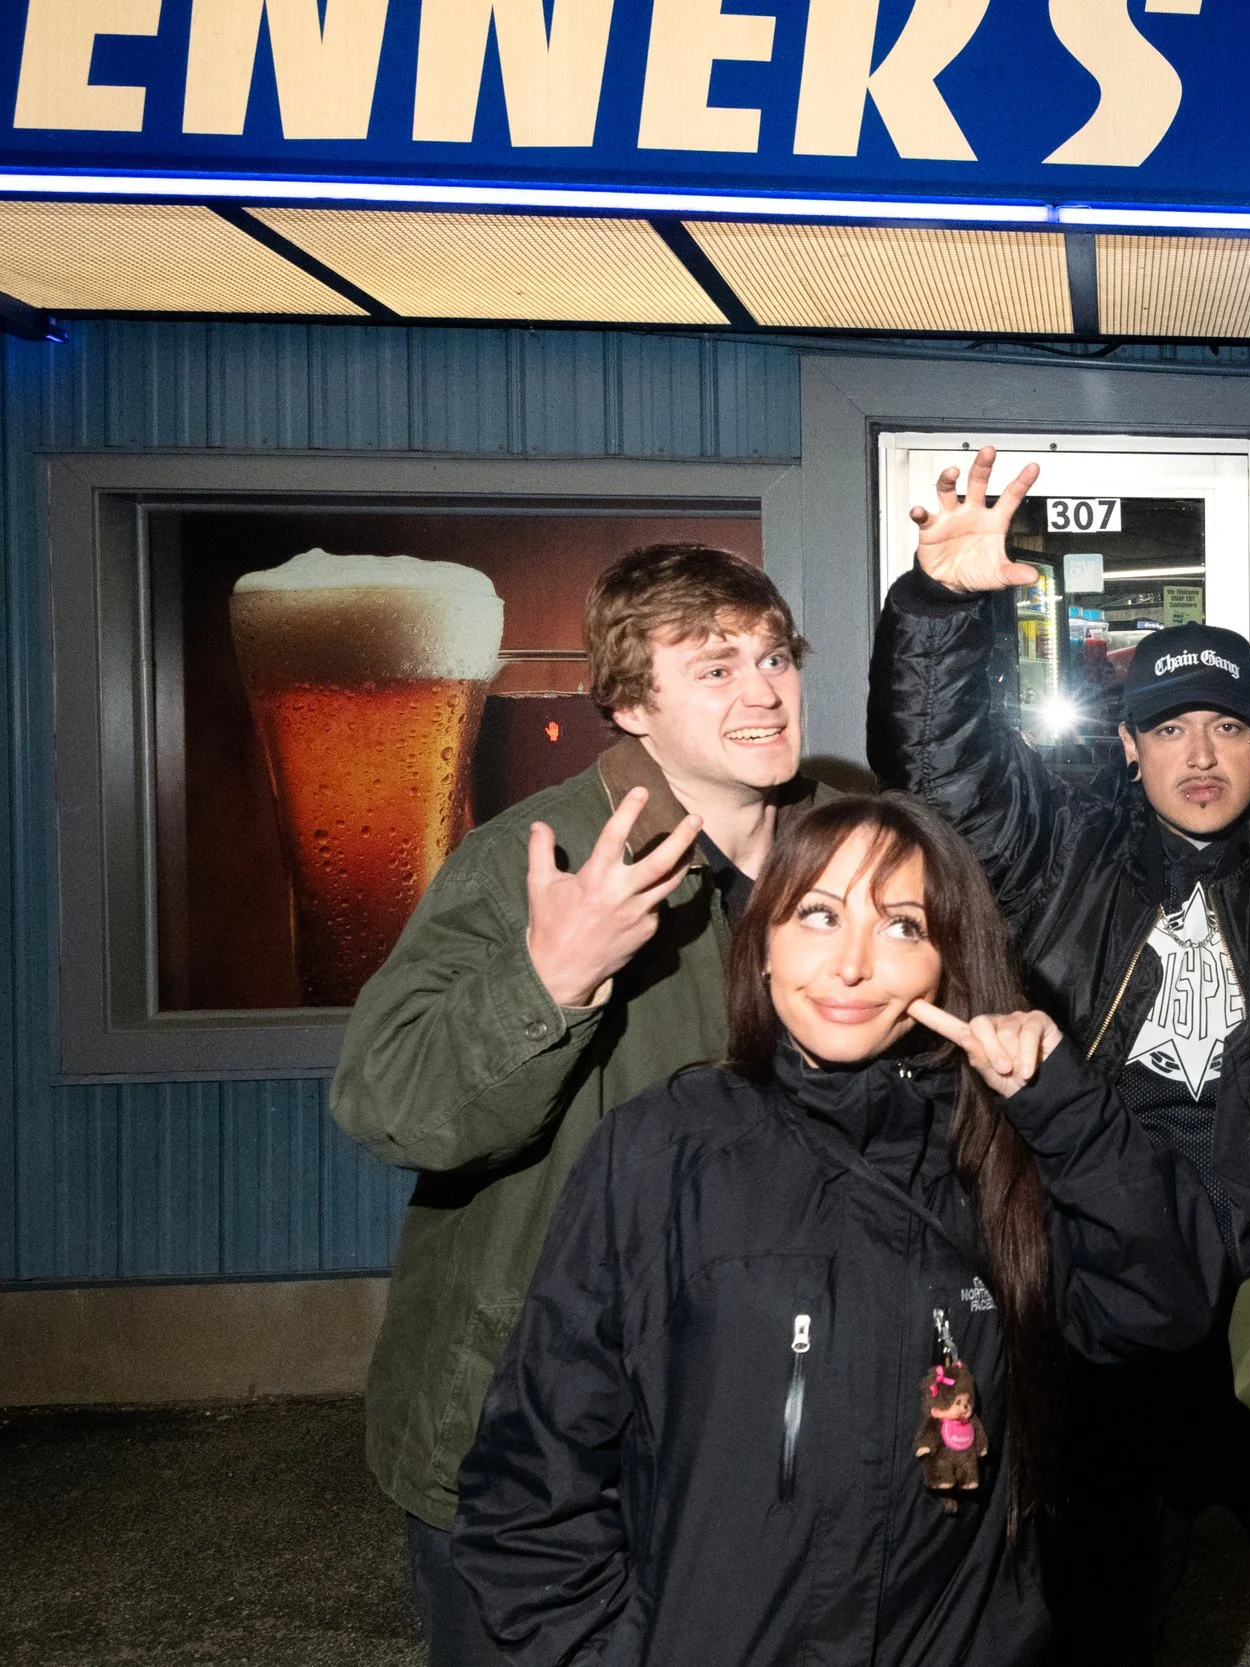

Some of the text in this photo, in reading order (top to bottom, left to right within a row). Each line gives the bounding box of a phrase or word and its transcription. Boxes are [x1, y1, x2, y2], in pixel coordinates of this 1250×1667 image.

[1051, 500, 1117, 530] 307
[1154, 649, 1240, 680] Chain Gang
